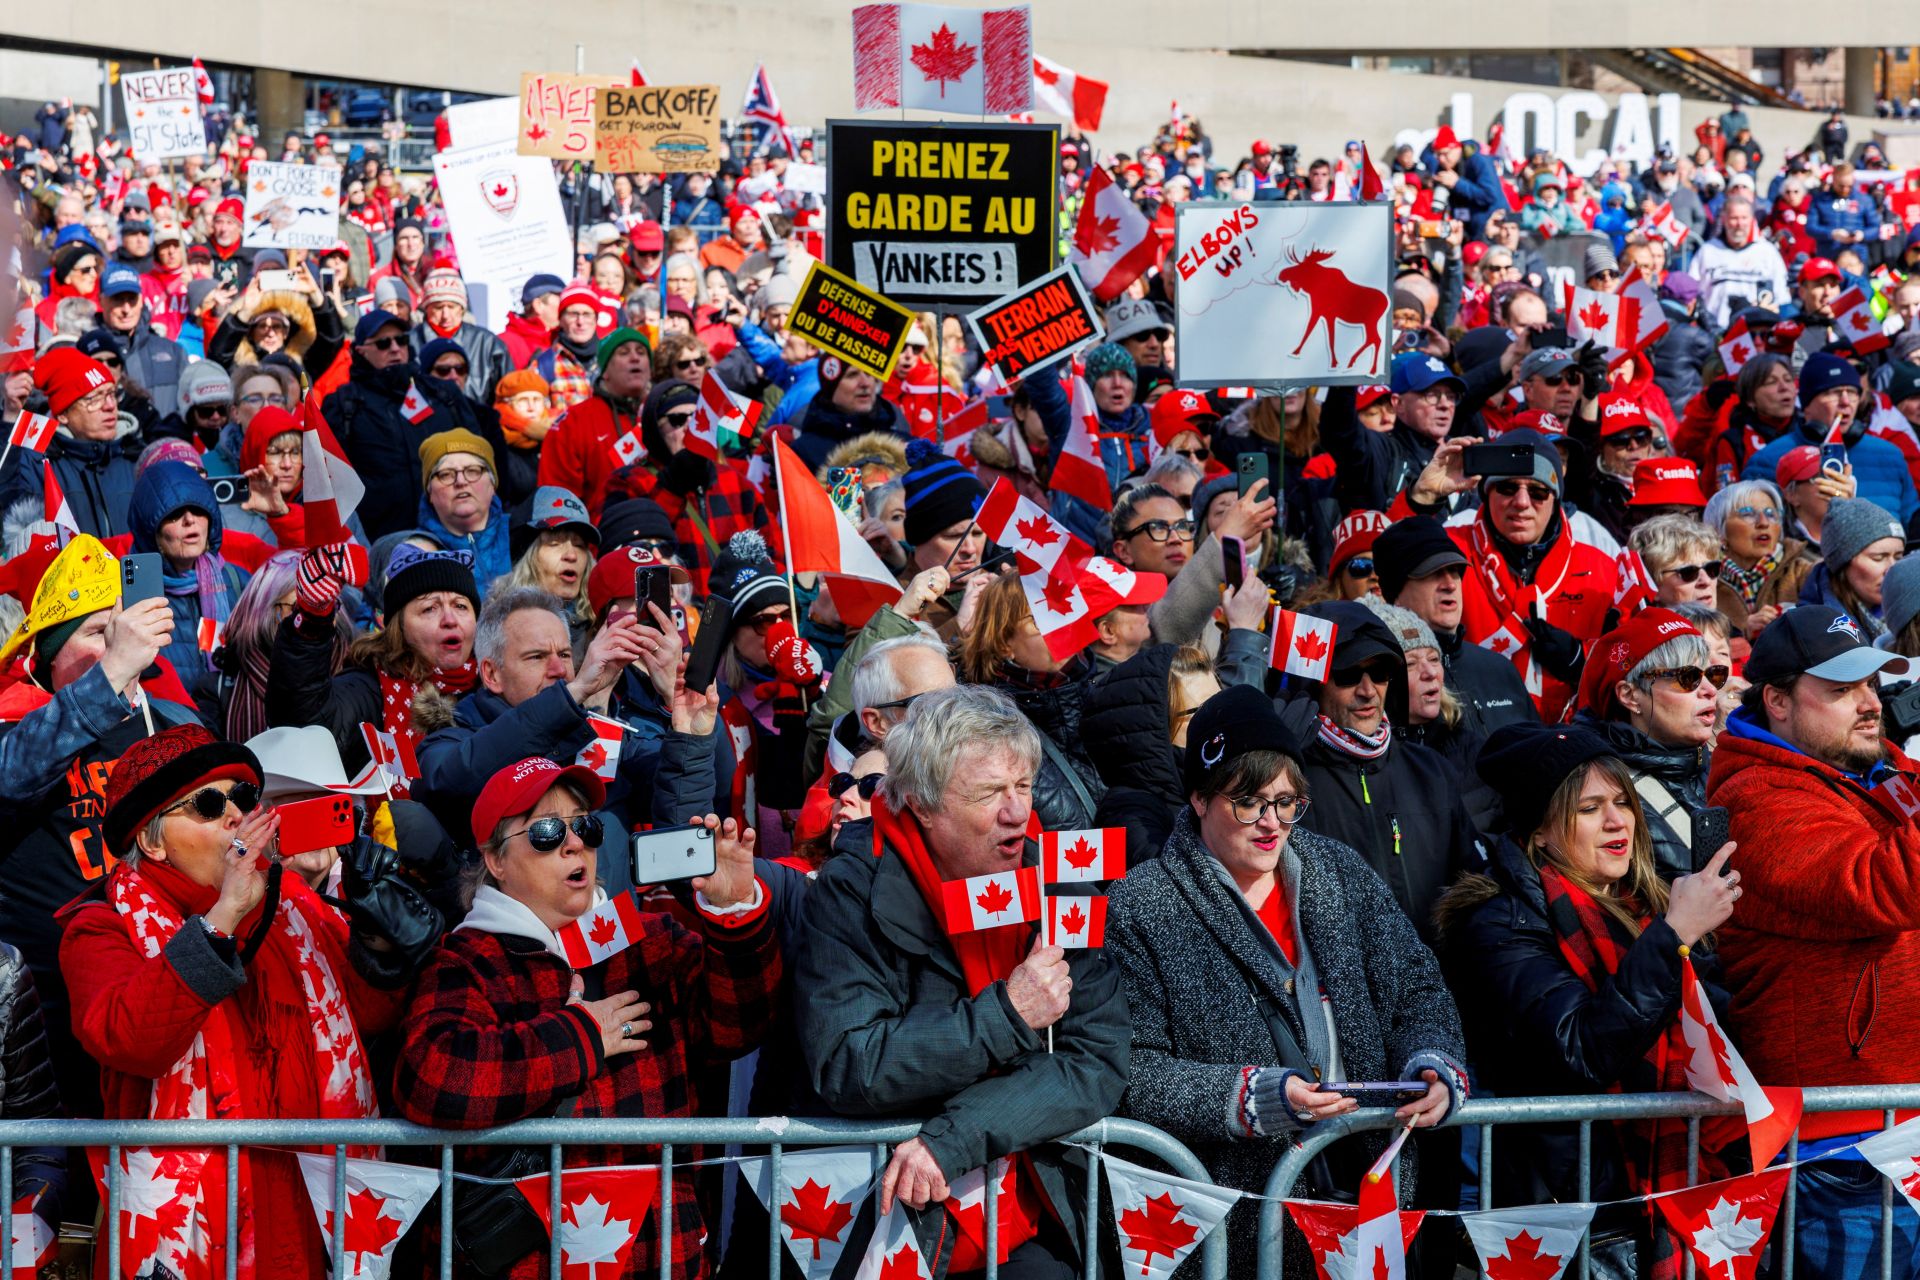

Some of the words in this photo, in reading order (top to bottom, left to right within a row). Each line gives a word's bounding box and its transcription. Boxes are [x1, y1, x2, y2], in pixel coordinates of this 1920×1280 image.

[125, 72, 194, 101] NEVER
[606, 88, 673, 119] BACK
[672, 88, 717, 125] OFF!
[161, 121, 202, 152] State
[599, 121, 622, 131] GET
[873, 140, 1010, 180] PRENEZ
[272, 179, 318, 197] GOOSE
[846, 191, 972, 232] GARDE
[983, 196, 1036, 235] AU
[1176, 206, 1259, 281] ELBOWS
[1215, 236, 1256, 278] UP!
[817, 298, 891, 348] D'ANNEXER
[985, 279, 1075, 342] TERRAIN
[795, 311, 816, 331] OU
[816, 322, 836, 342] DE
[835, 333, 887, 369] PASSER
[985, 337, 1019, 366] PAS
[1015, 308, 1091, 363] VENDRE
[85, 368, 105, 388] NA
[1655, 466, 1695, 480] Canada
[513, 766, 534, 783] NOT
